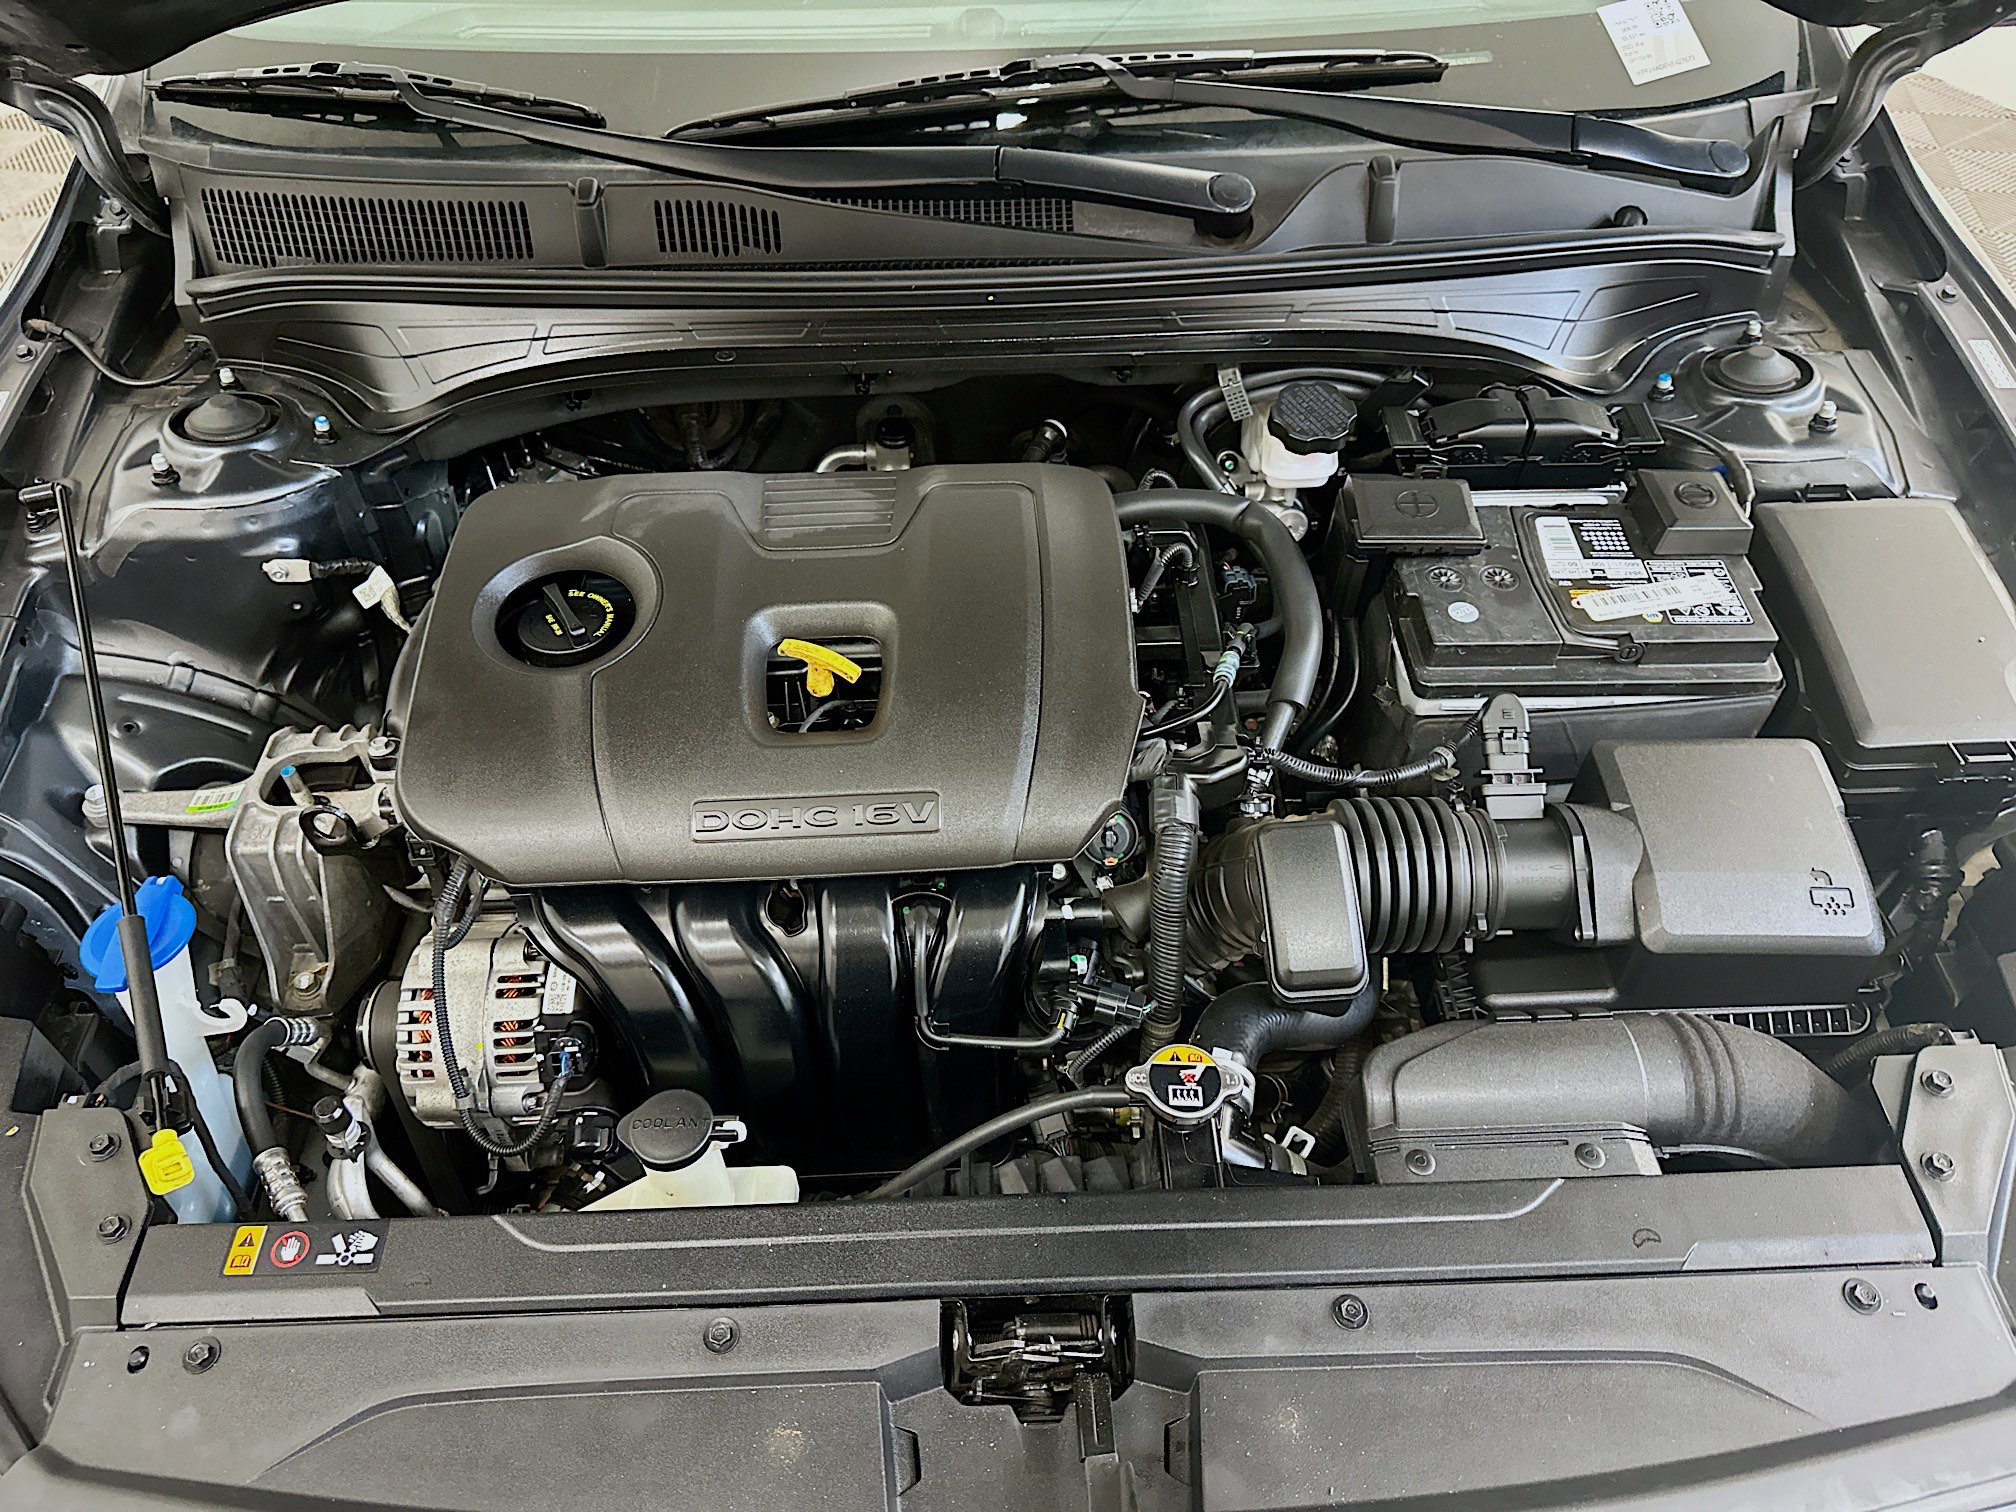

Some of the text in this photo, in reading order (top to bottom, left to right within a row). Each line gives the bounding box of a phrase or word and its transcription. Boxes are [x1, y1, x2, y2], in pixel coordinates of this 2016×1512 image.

[593, 613, 615, 636] MANUAL
[695, 801, 936, 833] DOHC 16V
[1128, 1072, 1147, 1084] HCC
[1225, 1074, 1240, 1085] 1.1
[632, 1117, 711, 1130] COOLANT
